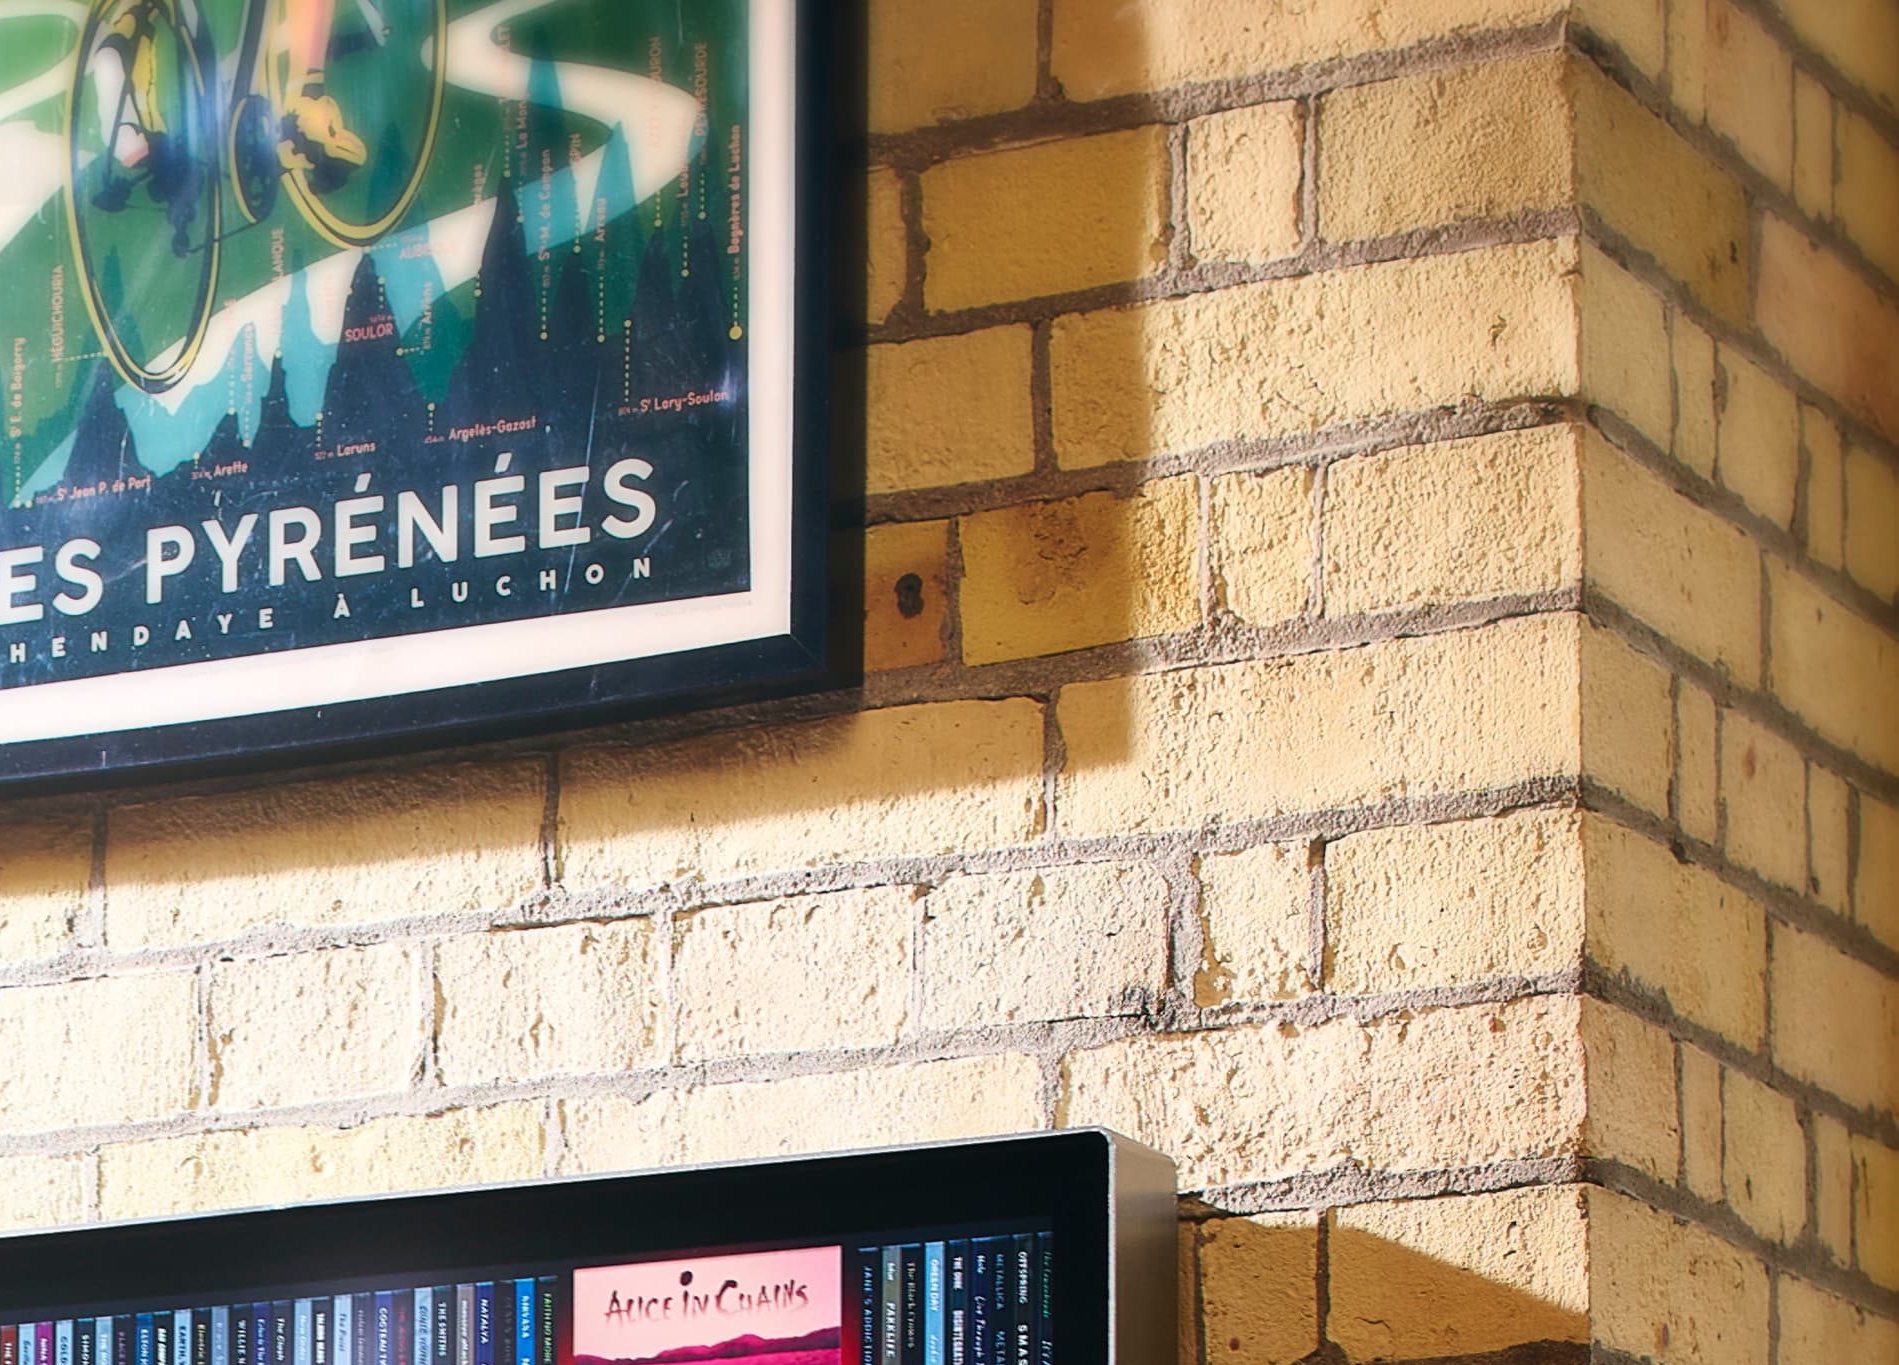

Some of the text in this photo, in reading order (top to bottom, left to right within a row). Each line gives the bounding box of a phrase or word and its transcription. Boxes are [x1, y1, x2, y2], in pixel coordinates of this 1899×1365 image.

[727, 124, 741, 173] Luchon
[728, 175, 741, 191] de
[345, 323, 394, 343] SOULOR
[70, 484, 96, 498] Jean
[112, 480, 126, 492] de
[128, 475, 152, 490] Port
[145, 452, 657, 605] PYRÉNÉES
[333, 592, 351, 618] À
[410, 557, 651, 608] LUCHON
[481, 1299, 489, 1345] NATALYA
[930, 1293, 939, 1312] DAY
[4, 1342, 12, 1359] THE
[277, 1318, 286, 1361] The Clash
[438, 1302, 447, 1357] THE SMITHS
[543, 1293, 552, 1364] FAITH NO MORE
[886, 1302, 895, 1359] PARKLIFE
